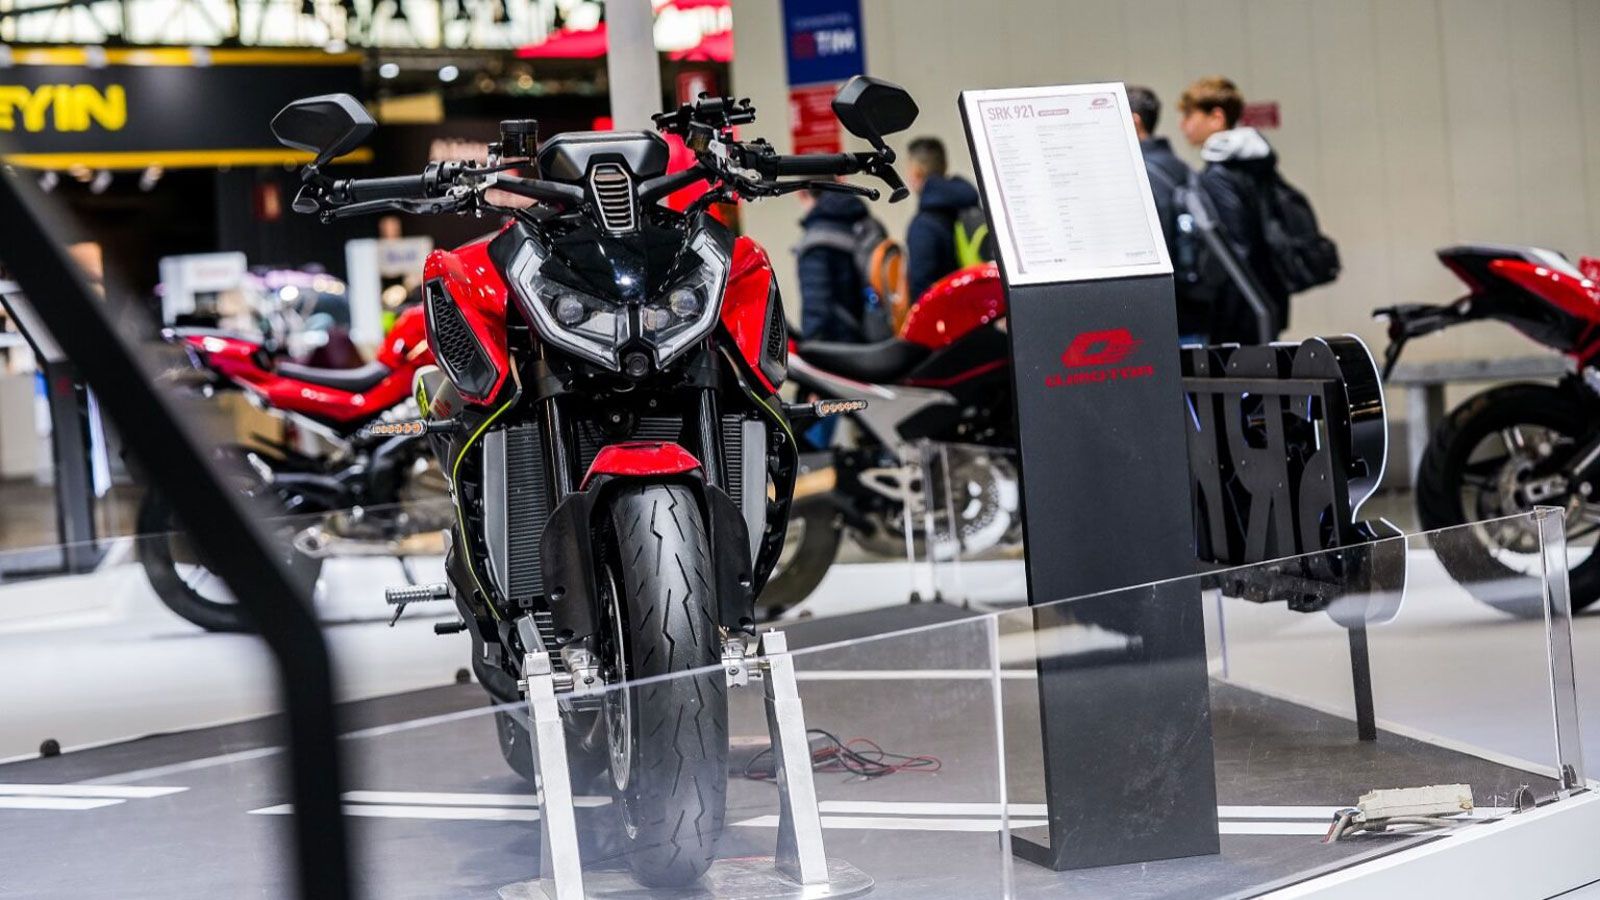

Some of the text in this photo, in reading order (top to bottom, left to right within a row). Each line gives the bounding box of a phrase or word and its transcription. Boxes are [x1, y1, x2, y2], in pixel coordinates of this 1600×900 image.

[816, 27, 857, 56] TIM
[987, 106, 1013, 120] SRK
[1014, 104, 1035, 119] 921
